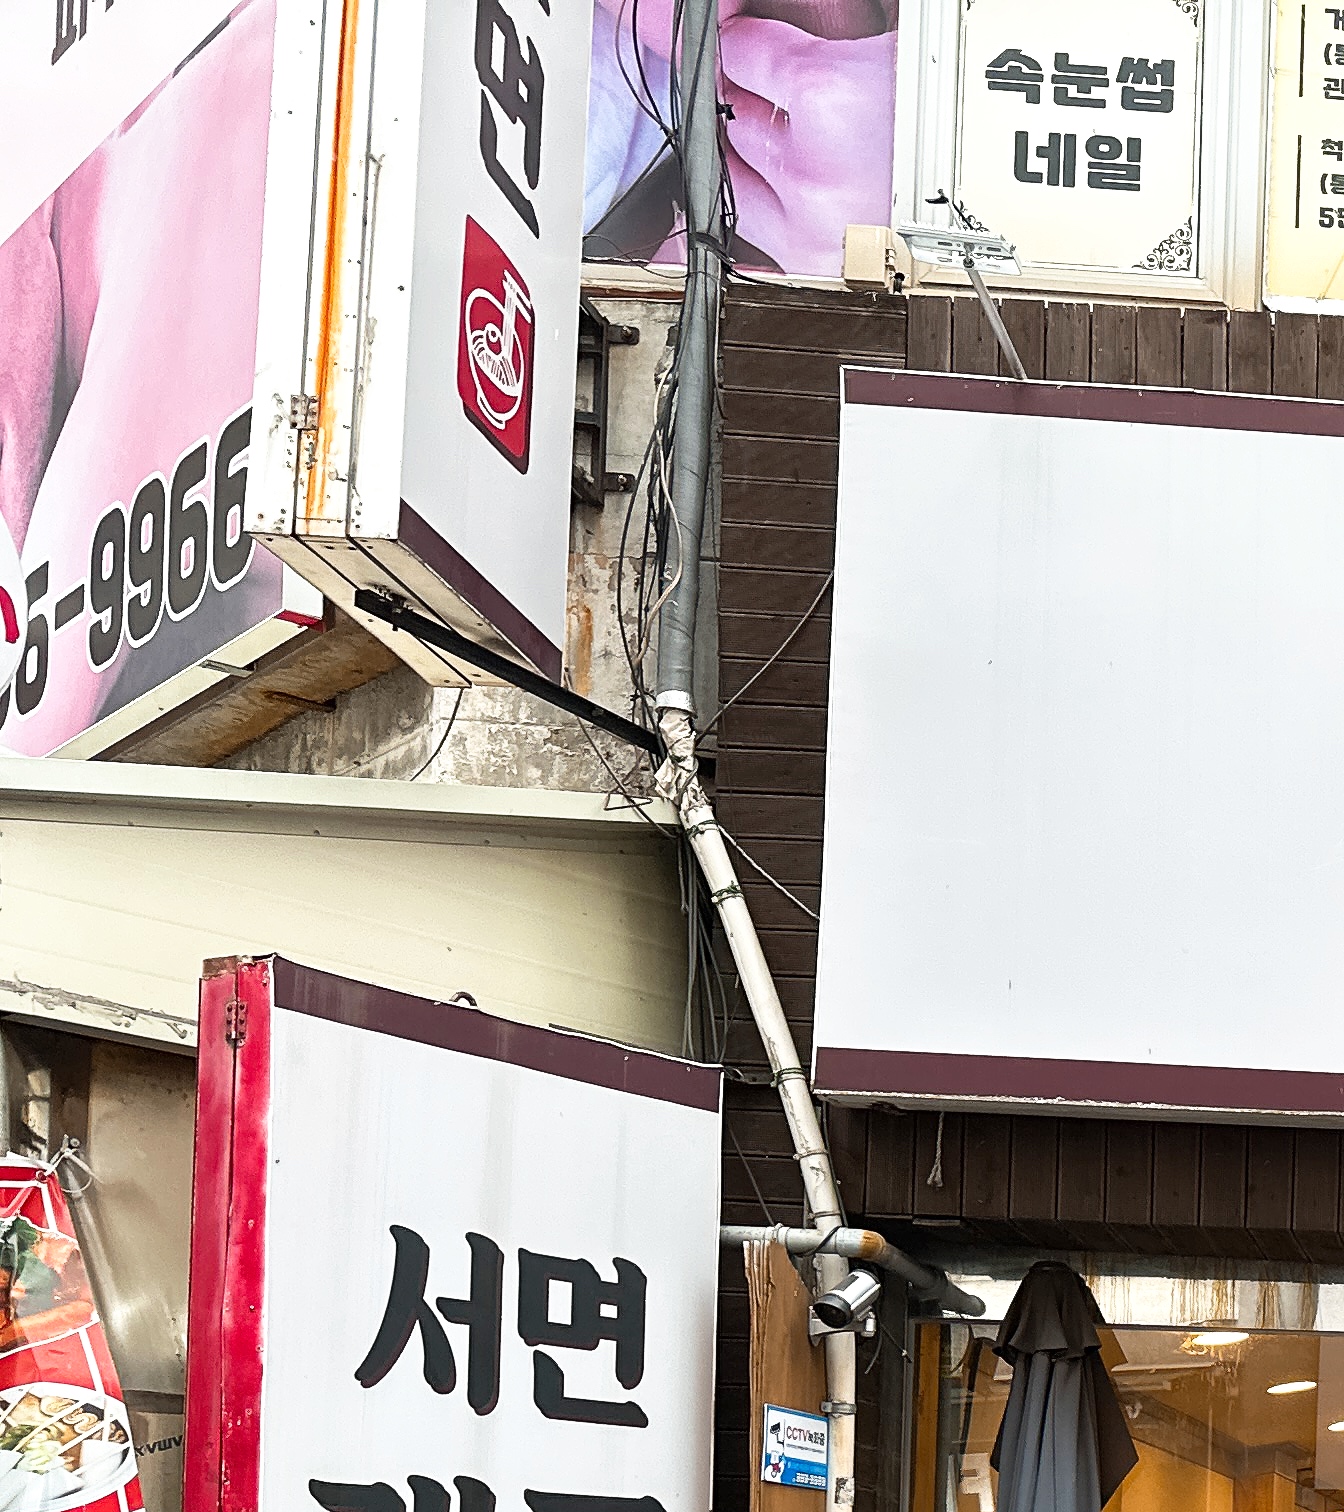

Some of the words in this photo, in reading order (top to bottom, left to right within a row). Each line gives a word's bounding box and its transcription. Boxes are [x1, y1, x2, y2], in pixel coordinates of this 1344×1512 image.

[475, 0, 546, 239] 면
[985, 49, 1176, 113] 속눈썹
[1014, 130, 1142, 191] 네일
[0, 406, 253, 722] 6-9966
[354, 1224, 648, 1428] 서면
